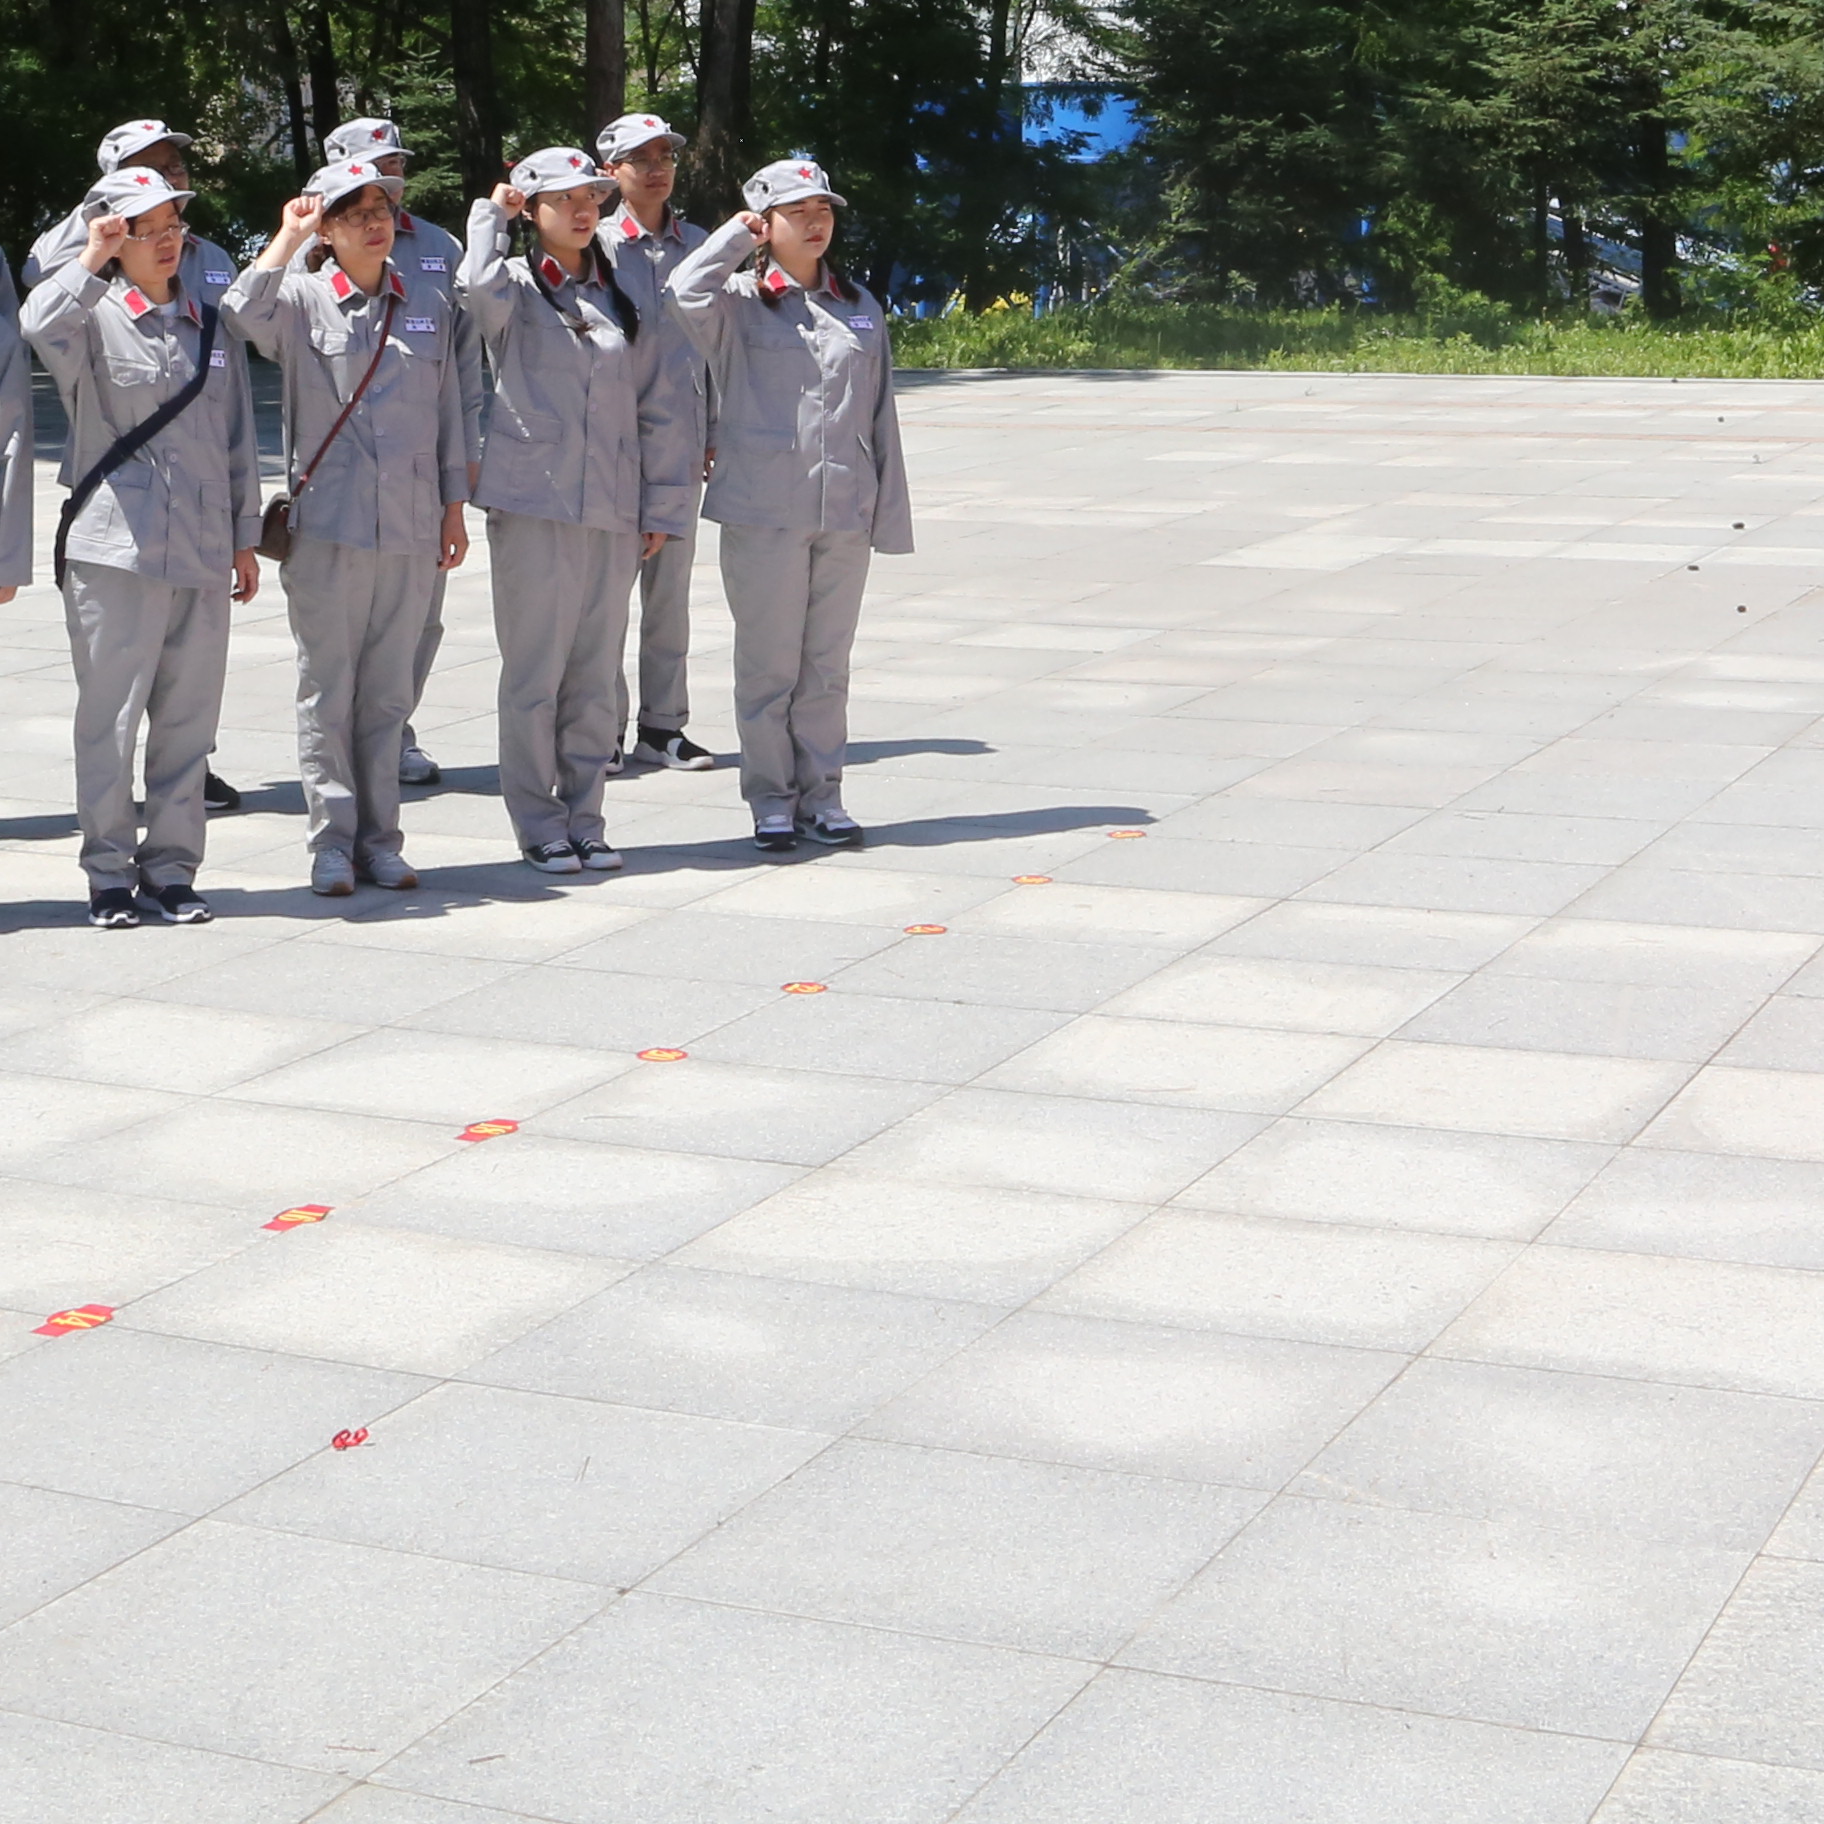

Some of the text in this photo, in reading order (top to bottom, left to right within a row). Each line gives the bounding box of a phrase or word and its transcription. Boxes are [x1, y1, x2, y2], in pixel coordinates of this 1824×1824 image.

[468, 1122, 513, 1134] 18
[278, 1209, 325, 1222] 16
[53, 1311, 105, 1327] 14
